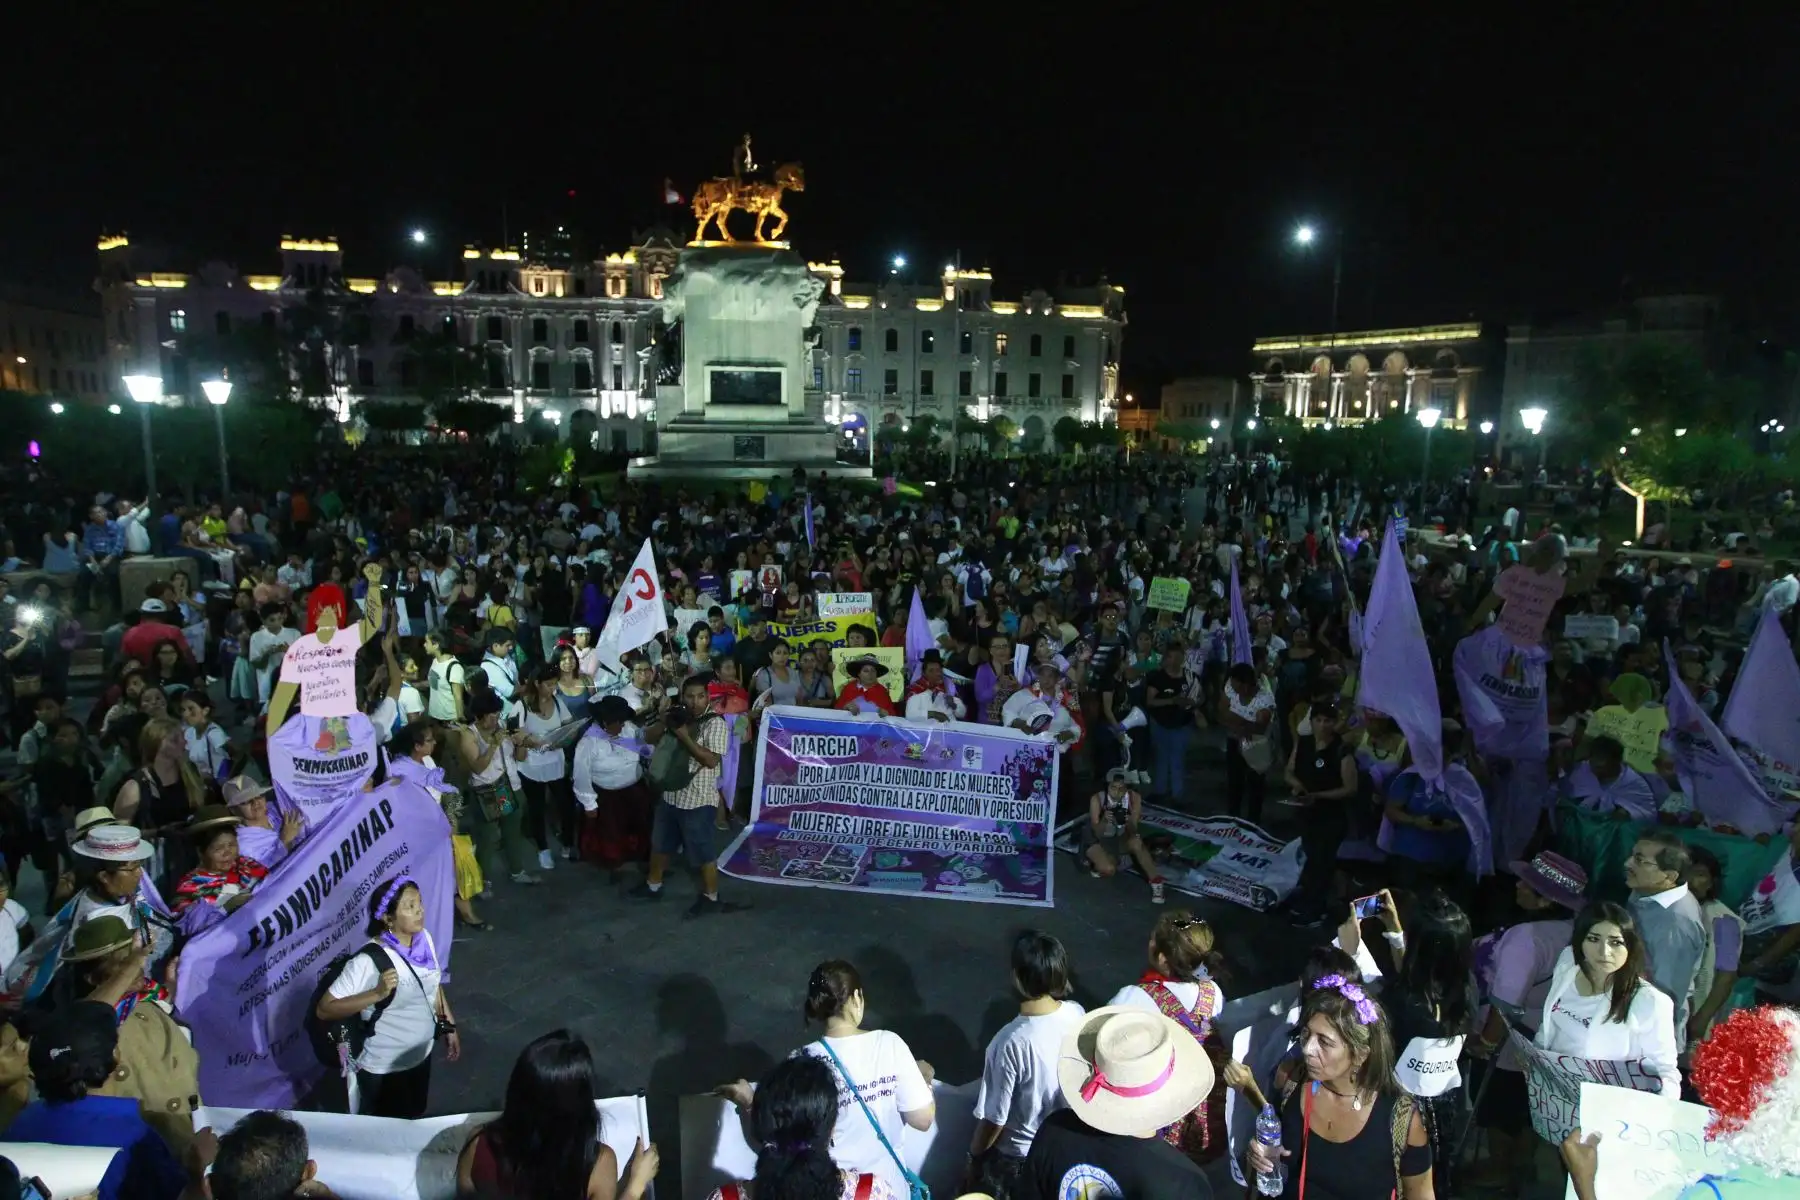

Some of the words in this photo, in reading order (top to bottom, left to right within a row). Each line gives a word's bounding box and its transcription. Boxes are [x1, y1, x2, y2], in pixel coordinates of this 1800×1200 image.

[766, 621, 838, 638] UJERES
[793, 737, 857, 755] MARCHA
[825, 766, 836, 780] LA
[839, 764, 860, 781] VIDA
[863, 764, 870, 781] Y
[871, 766, 883, 783] LA
[885, 766, 932, 788] DIGNIDAD
[934, 770, 945, 789] DE
[948, 772, 966, 791] LAS
[768, 787, 821, 805] LUCHAMOS
[822, 785, 858, 803] UNIDAS
[860, 788, 898, 808] CONTRA
[901, 790, 913, 809] LA
[915, 793, 980, 816] EXPLOTACIÓN
[982, 799, 990, 817] Y
[990, 800, 1044, 821] OPRESIÓN!
[791, 812, 849, 834] MUJERES
[852, 818, 889, 837] LIBRE
[893, 822, 910, 839] DE
[913, 825, 981, 843] VIOLENCIA
[799, 832, 863, 845] IGUALDAD
[866, 837, 882, 847] DE
[940, 841, 952, 851] Y
[368, 842, 410, 887] CAMPESINAS
[288, 936, 332, 979] INDIGENAS
[330, 912, 362, 946] NATIVAS
[1406, 1057, 1457, 1074] SEGURIDA
